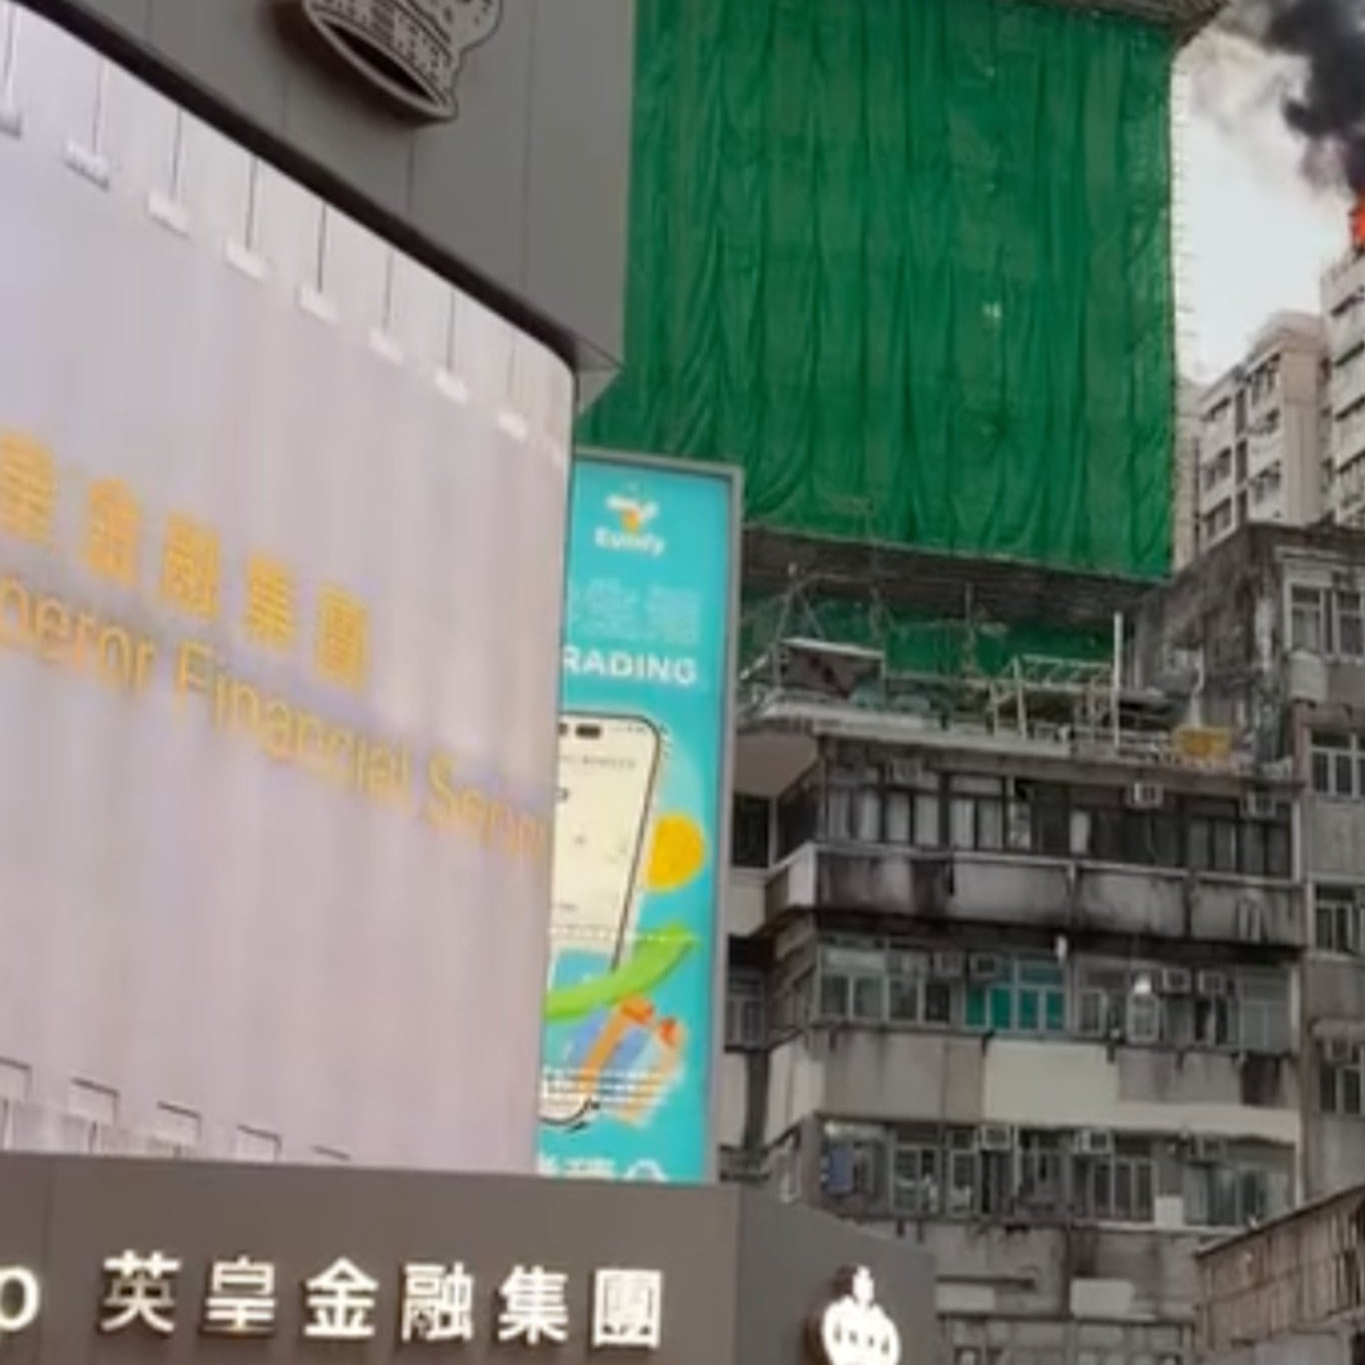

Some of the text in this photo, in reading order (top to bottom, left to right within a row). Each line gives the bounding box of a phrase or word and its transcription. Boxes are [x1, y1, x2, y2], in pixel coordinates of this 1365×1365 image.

[101, 1249, 664, 1348] 英皇金融集團
